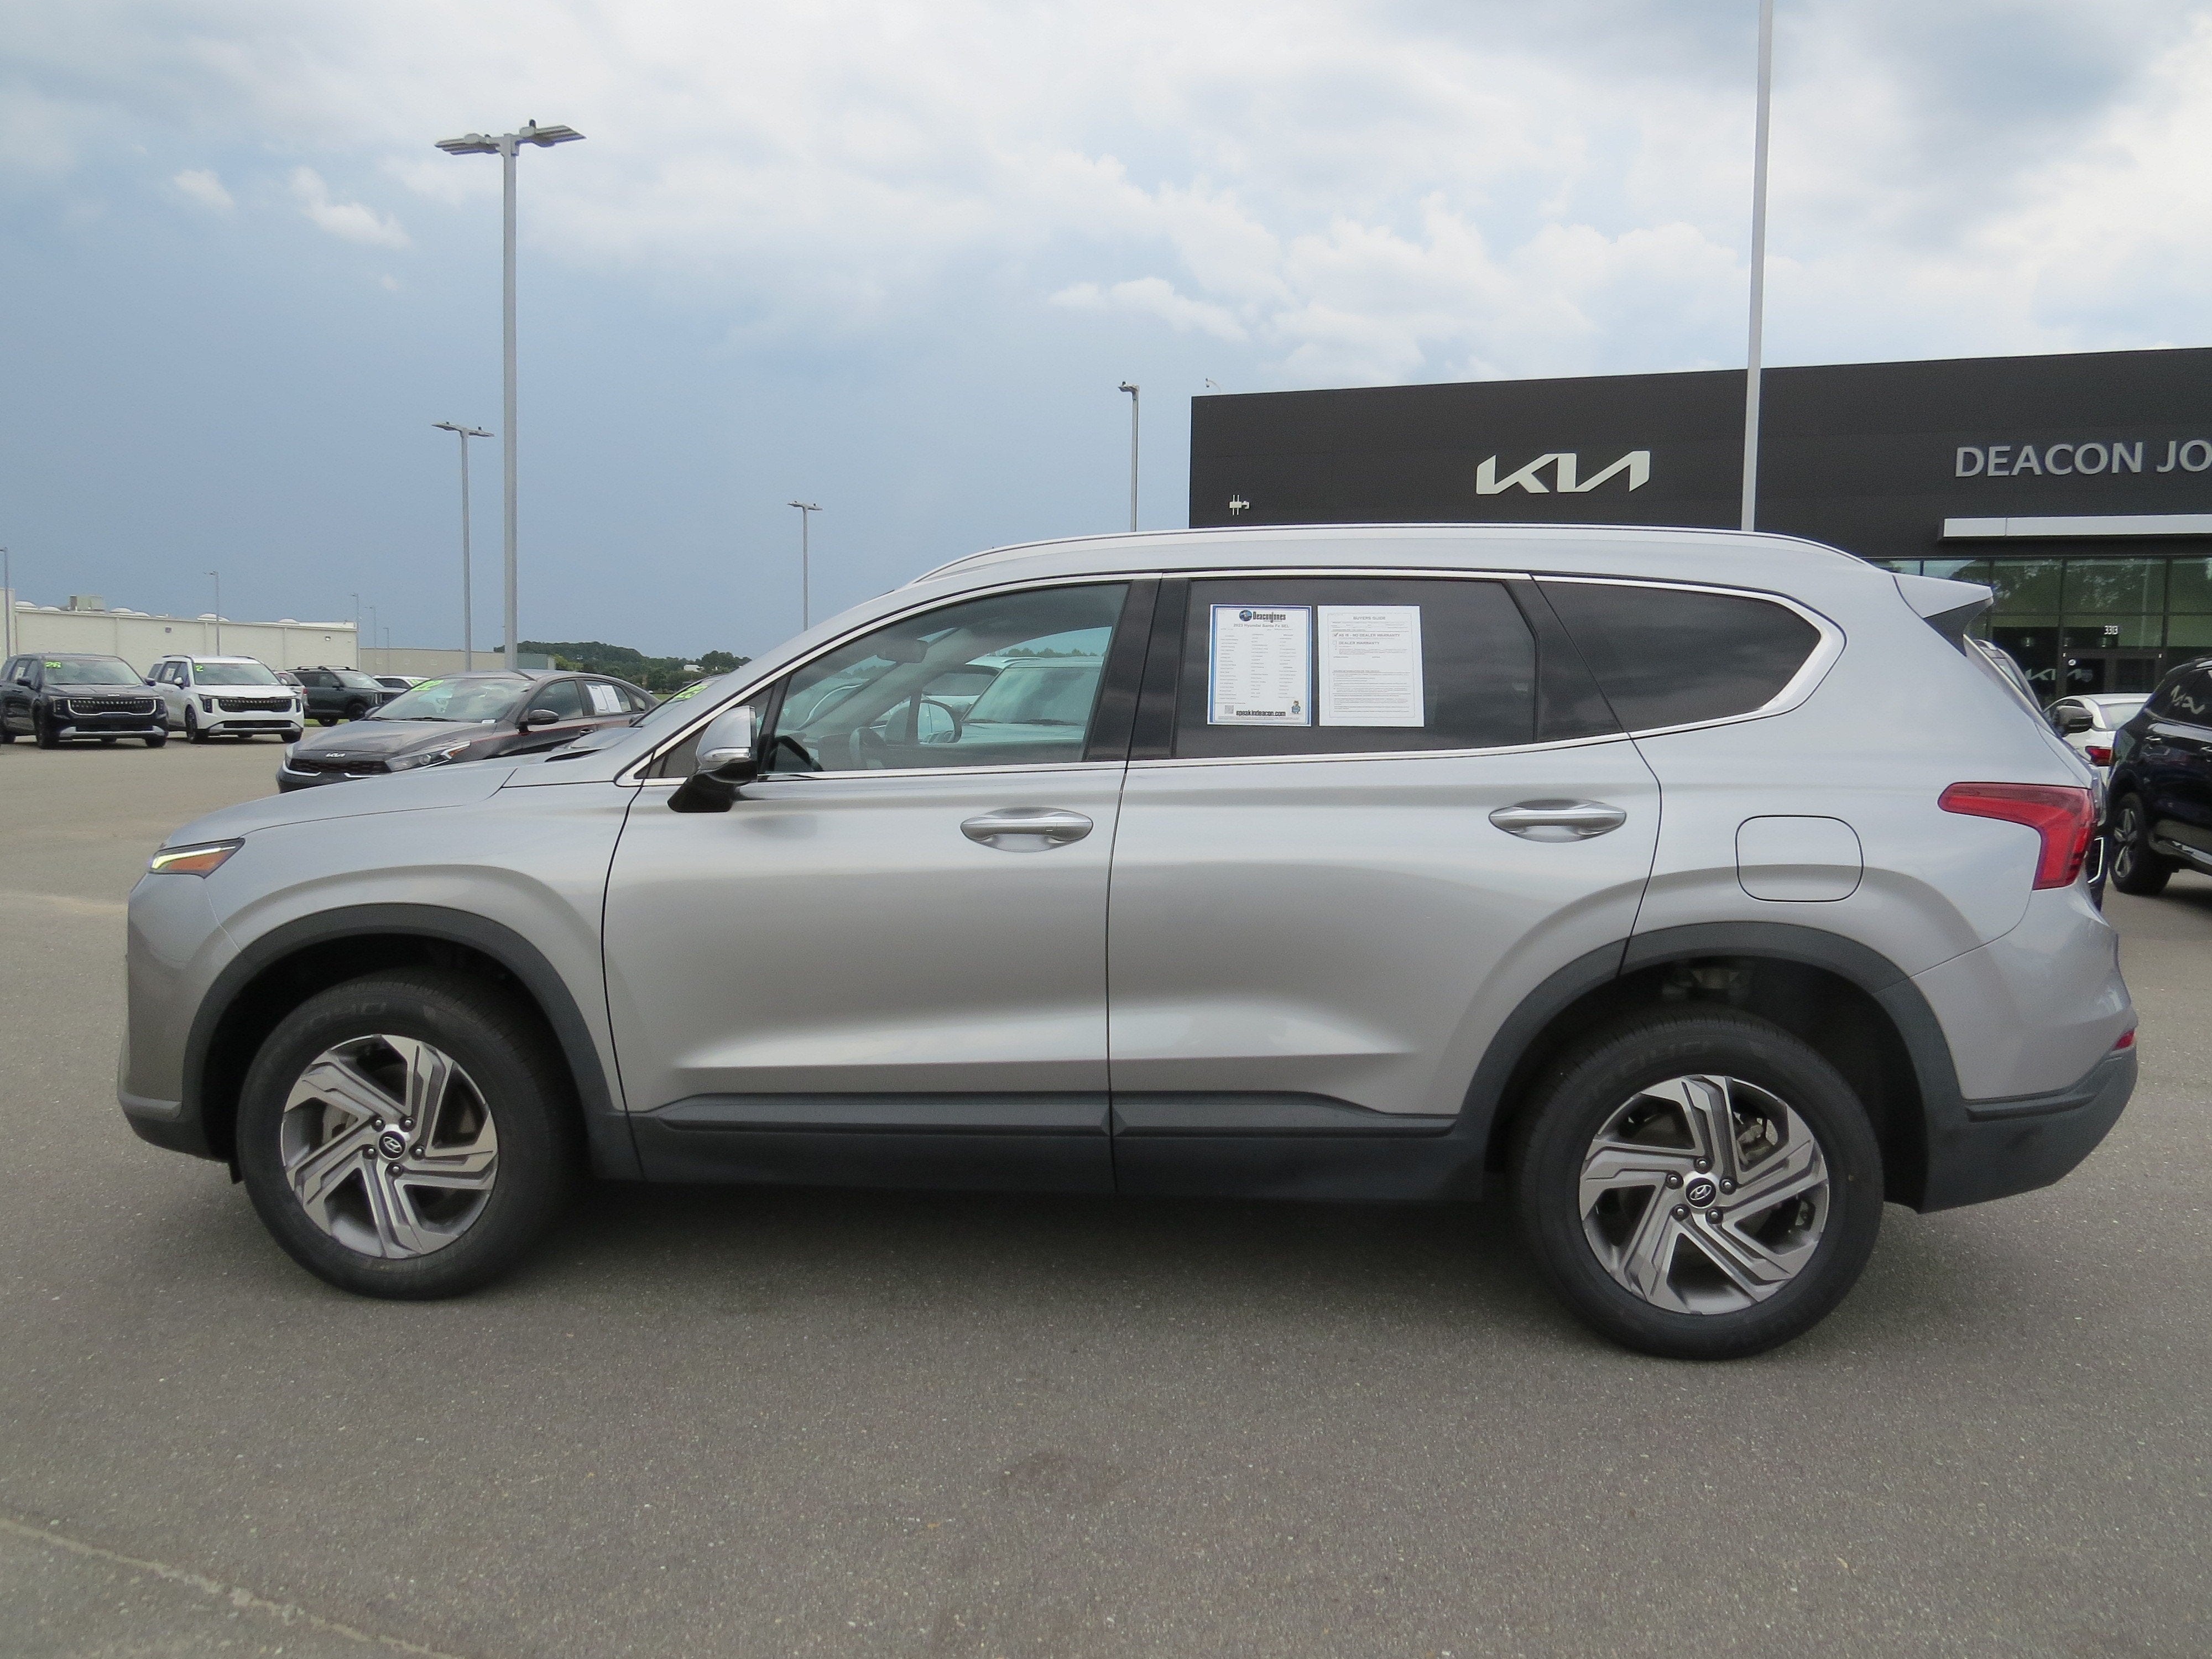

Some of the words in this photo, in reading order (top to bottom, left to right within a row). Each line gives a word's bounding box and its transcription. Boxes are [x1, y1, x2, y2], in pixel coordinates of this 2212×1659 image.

[1476, 450, 1651, 495] KIA
[1955, 442, 2143, 478] DEACON
[2156, 439, 2212, 473] JO
